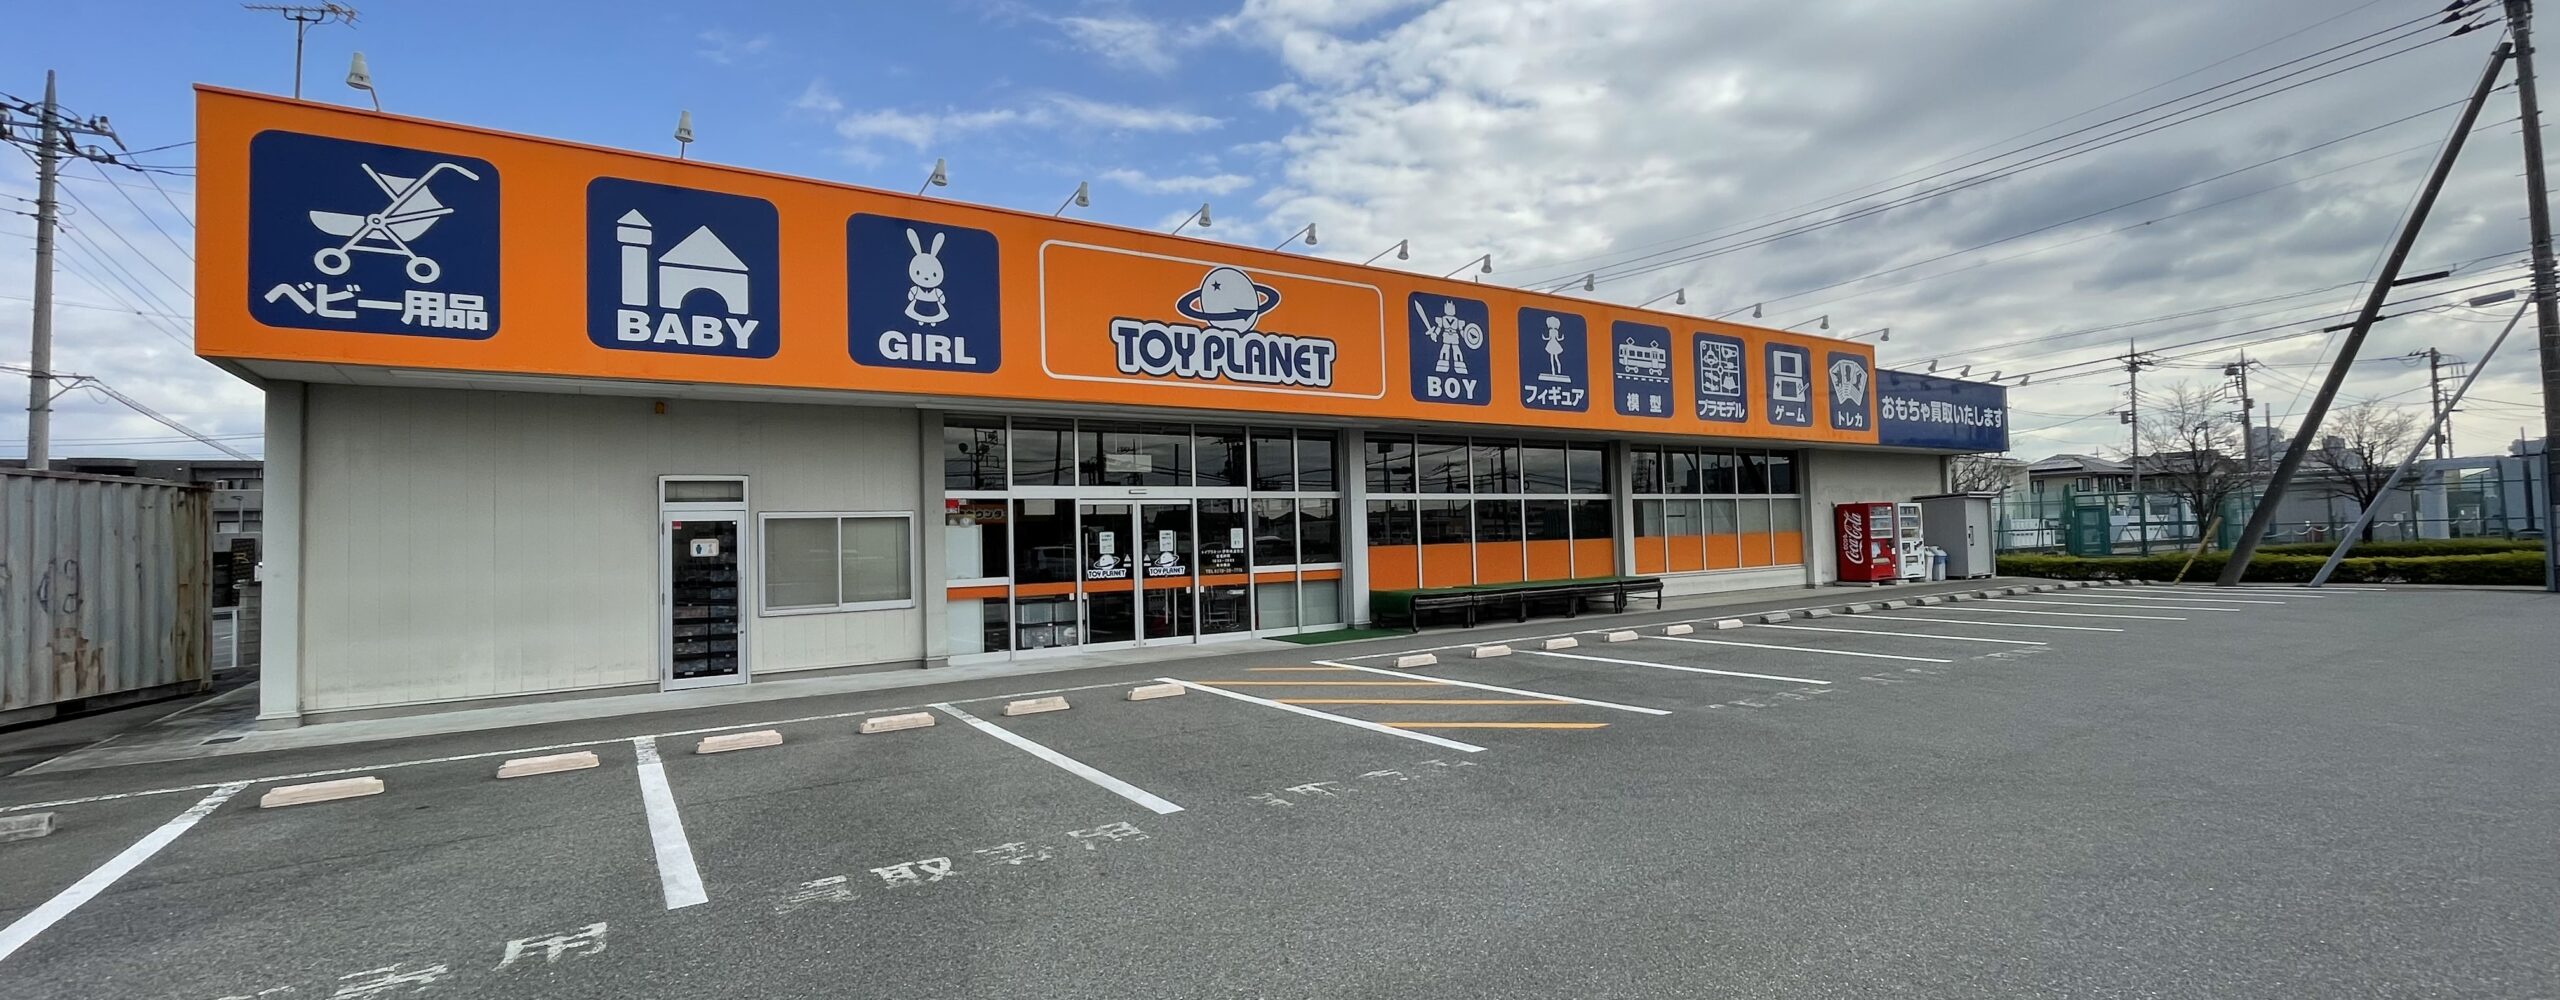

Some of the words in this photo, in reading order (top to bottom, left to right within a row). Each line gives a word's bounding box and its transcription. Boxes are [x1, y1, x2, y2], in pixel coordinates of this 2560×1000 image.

[264, 280, 489, 332] ベビー用品
[616, 308, 760, 350] BABY
[878, 329, 977, 366] GIRL
[1426, 374, 1477, 401] BOY
[1524, 384, 1585, 408] フィギュア
[1697, 399, 1745, 419] プラモデル
[1774, 404, 1806, 424] ゲーム
[1837, 410, 1863, 428] トレカ
[1881, 394, 2004, 429] おもちゃ買取いたします
